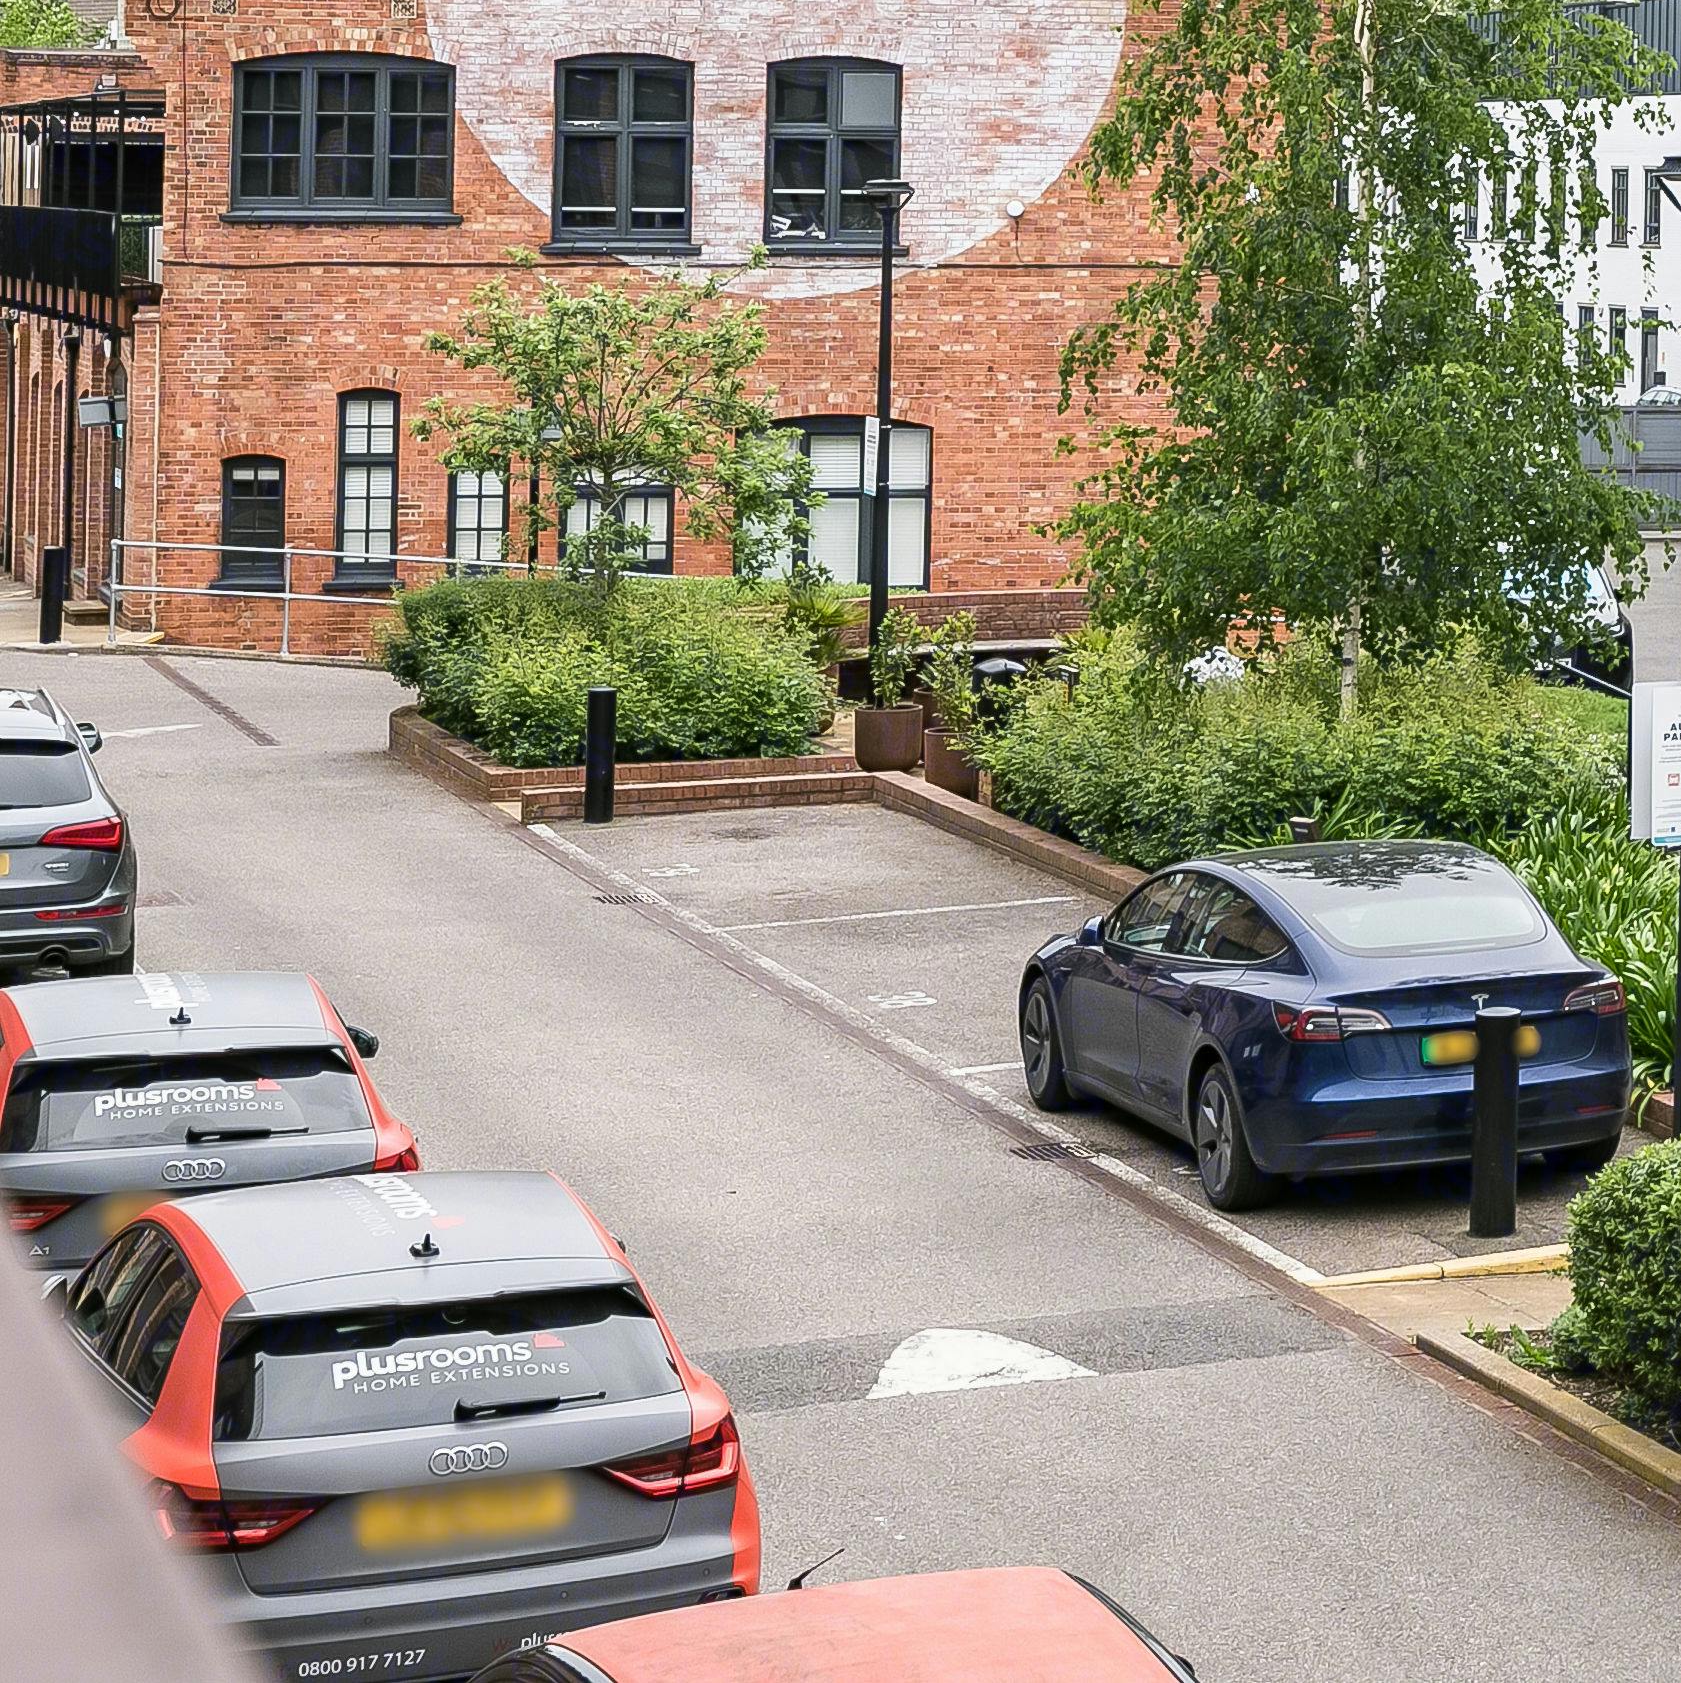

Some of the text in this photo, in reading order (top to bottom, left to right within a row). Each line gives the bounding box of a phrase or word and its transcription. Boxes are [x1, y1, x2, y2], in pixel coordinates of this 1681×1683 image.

[94, 1084, 256, 1117] plusrooms
[109, 1100, 285, 1120] HOME EXTENSIONS
[332, 1341, 532, 1390] plusrooms
[354, 1361, 570, 1394] HOME EXTENSIONS
[298, 1649, 427, 1677] 0800 917 7127
